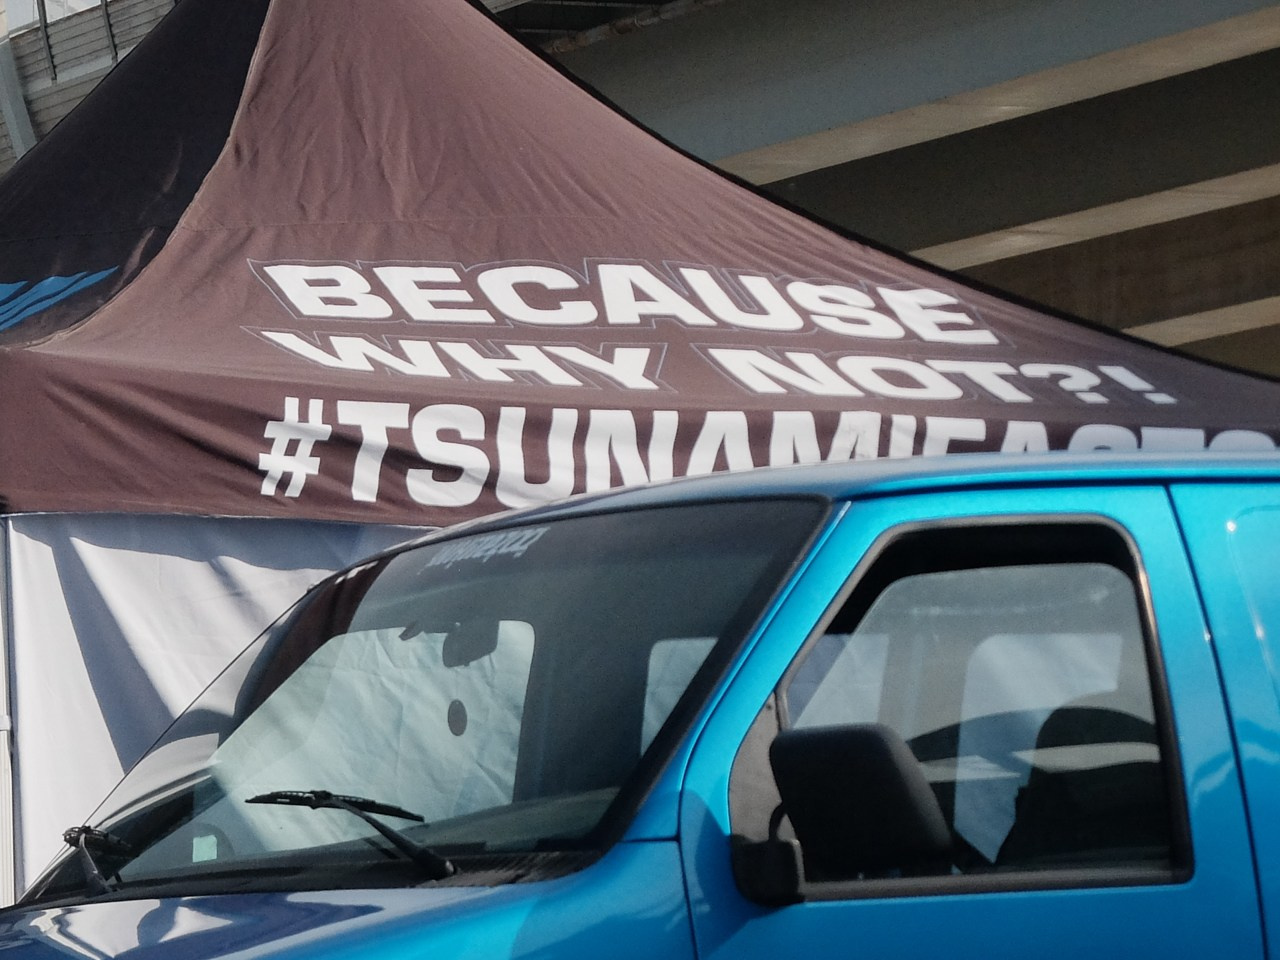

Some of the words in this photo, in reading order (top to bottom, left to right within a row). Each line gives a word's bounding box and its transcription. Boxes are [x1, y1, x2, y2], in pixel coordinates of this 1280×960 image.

[263, 263, 999, 345] BECAUSE
[260, 330, 659, 390] WHY
[708, 348, 1177, 404] NOT?!
